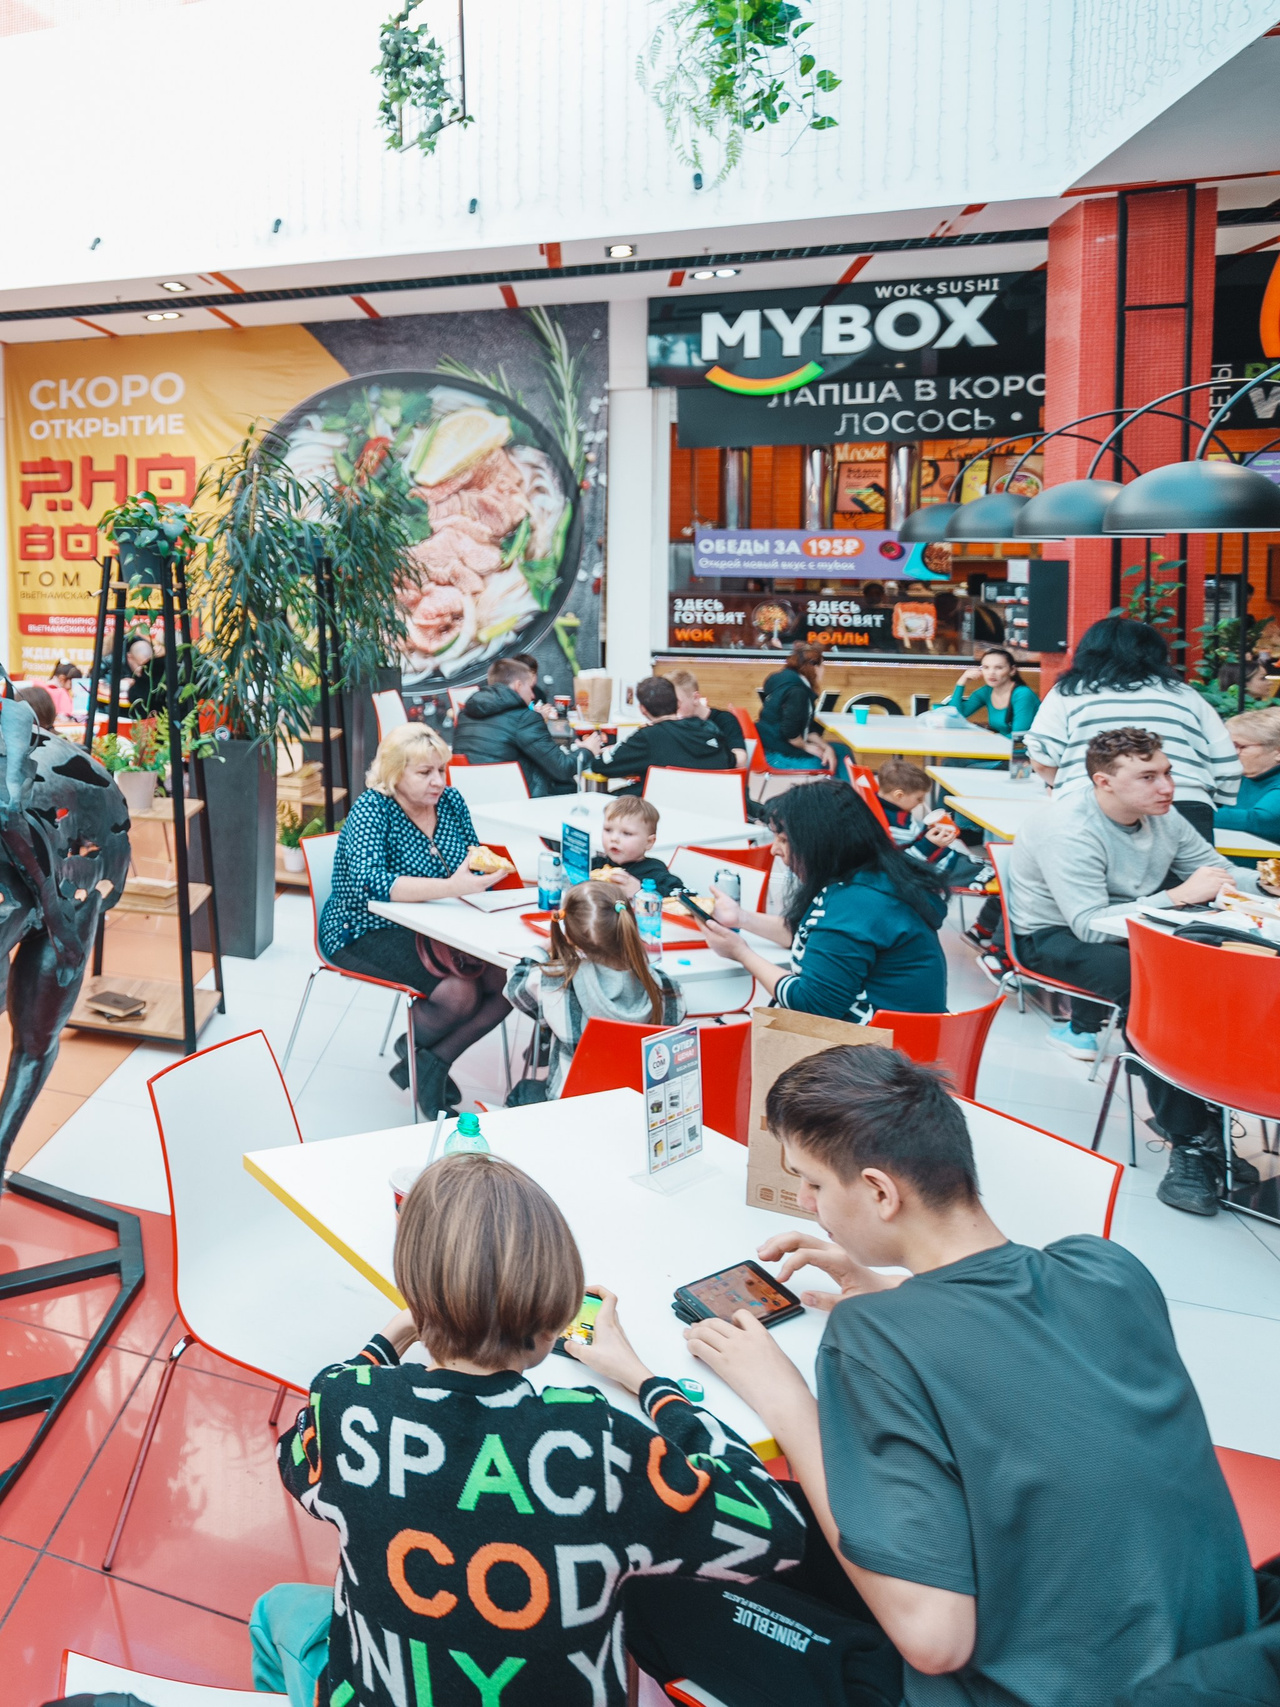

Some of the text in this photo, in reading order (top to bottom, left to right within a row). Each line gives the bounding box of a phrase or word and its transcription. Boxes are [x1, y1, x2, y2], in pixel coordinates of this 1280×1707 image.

[701, 294, 999, 361] MYBOX
[28, 371, 186, 412] СКОРО
[766, 380, 904, 408] ЛАПША
[914, 378, 939, 402] В
[28, 413, 186, 440] ОТКРЫТИЕ
[833, 408, 997, 436] ЛОСОСЬ
[698, 538, 771, 556] ОБЕДЫ
[773, 539, 802, 556] ЗА
[698, 557, 741, 571] Открой
[742, 558, 778, 571] новый
[780, 560, 807, 572] вкус
[674, 598, 724, 612] ЗДЕСЬ
[806, 600, 862, 614] ЗДЕСЬ
[673, 611, 747, 625] ГОТОВЯТ
[806, 614, 885, 628] ГОТОВЯТ
[674, 628, 716, 643] WOK
[806, 631, 870, 646] РОЛЛЫ
[732, 1605, 811, 1653] PRINEBLUE
